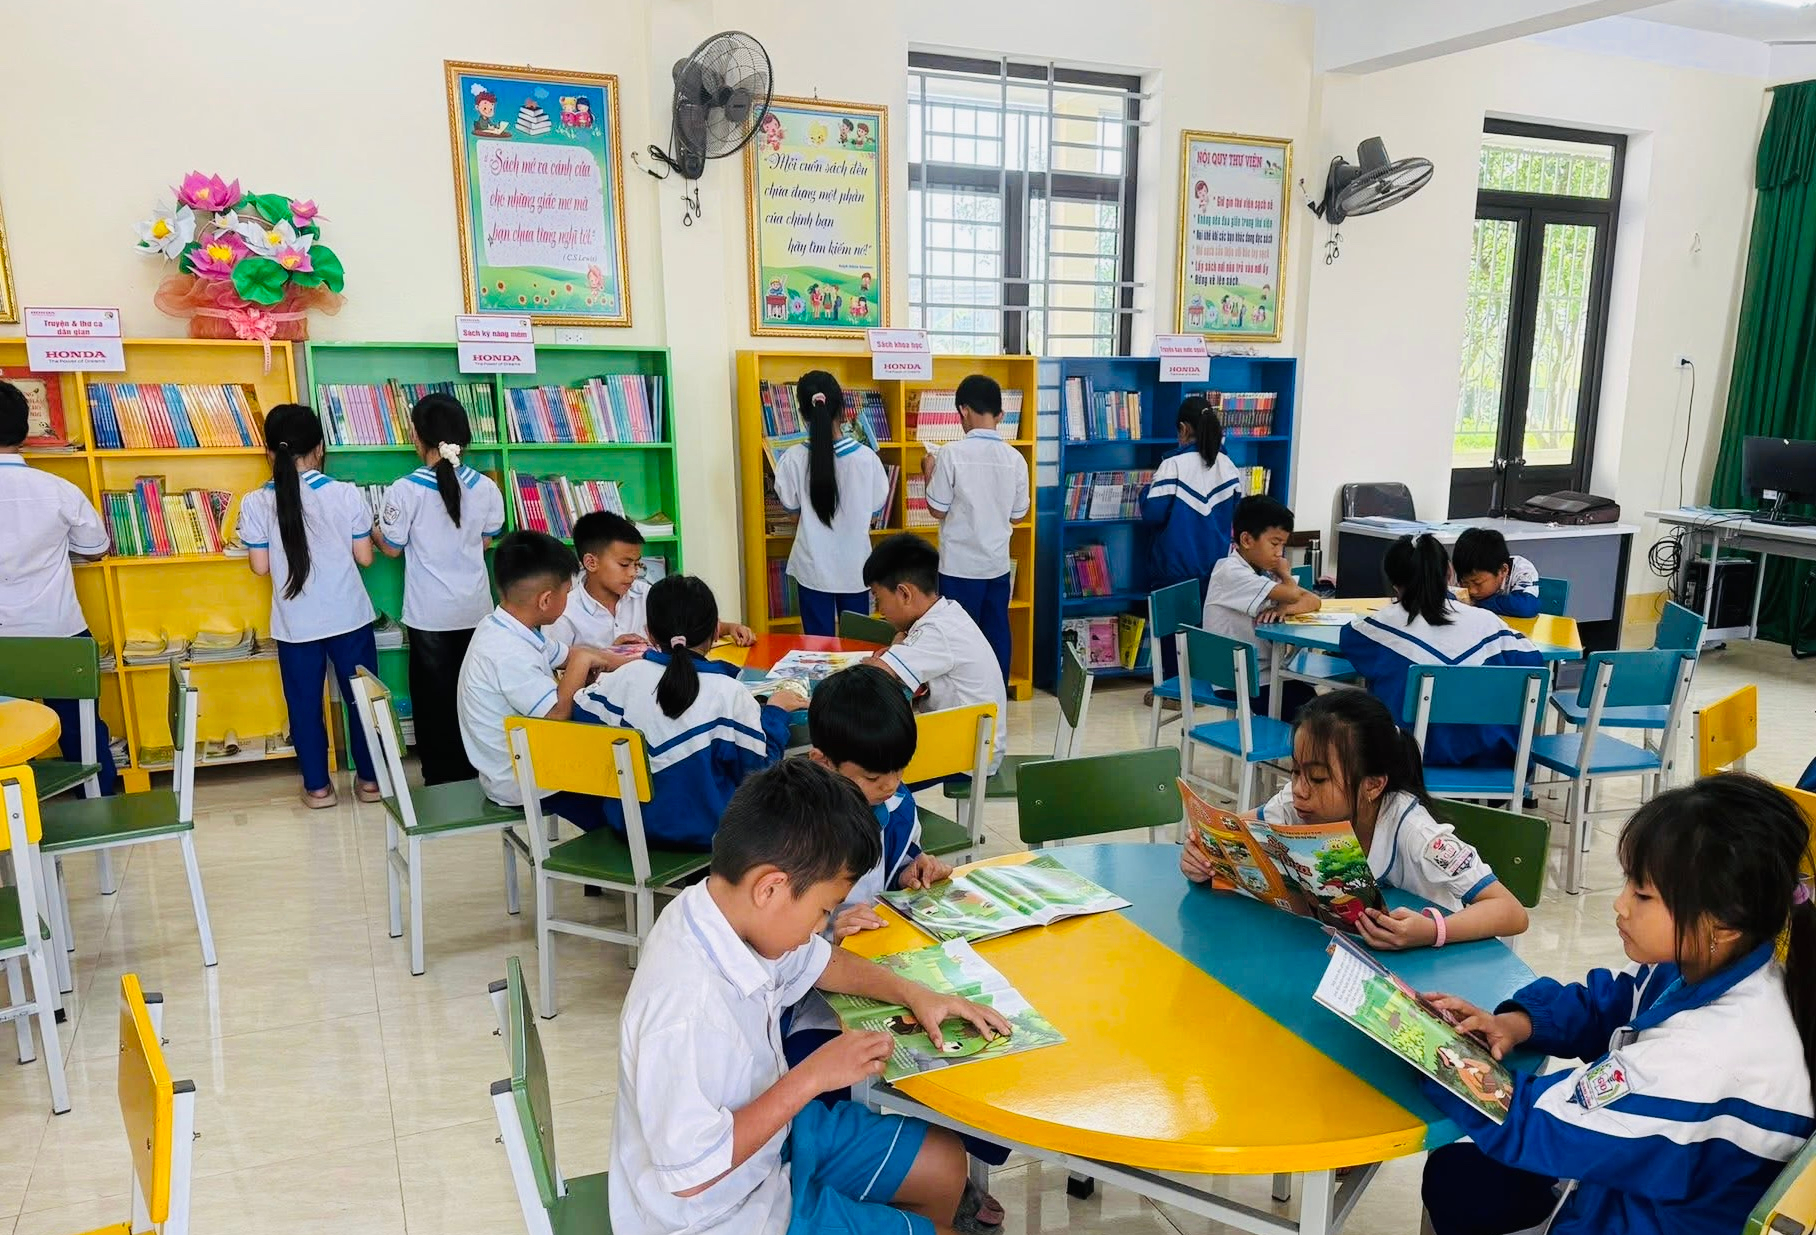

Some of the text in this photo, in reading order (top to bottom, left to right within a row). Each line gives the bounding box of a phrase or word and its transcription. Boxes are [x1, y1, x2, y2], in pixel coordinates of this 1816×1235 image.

[1211, 152, 1227, 166] QUY
[537, 161, 548, 175] ra
[824, 160, 847, 177] sách
[489, 187, 505, 212] cho
[815, 212, 834, 229] bạn
[492, 221, 510, 243] bạn
[472, 354, 522, 362] HONDA
